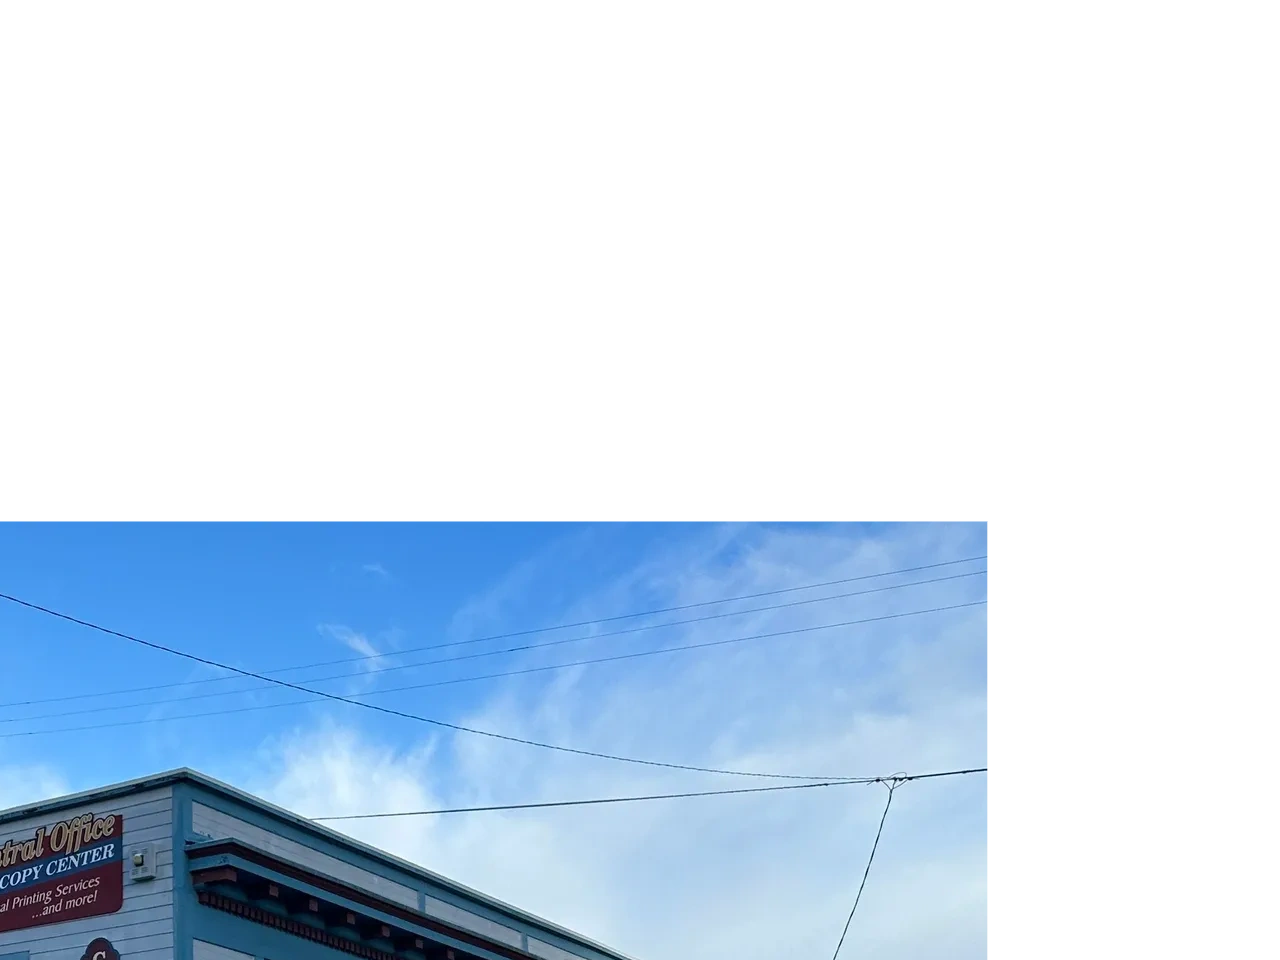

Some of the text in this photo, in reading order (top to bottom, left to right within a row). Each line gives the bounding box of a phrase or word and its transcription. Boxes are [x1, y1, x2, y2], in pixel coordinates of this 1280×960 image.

[50, 812, 116, 855] Office
[0, 864, 44, 890] COPY
[45, 843, 115, 876] CENTER
[11, 889, 53, 910] Printing
[55, 876, 101, 897] Services
[31, 889, 98, 919] ...and more!
